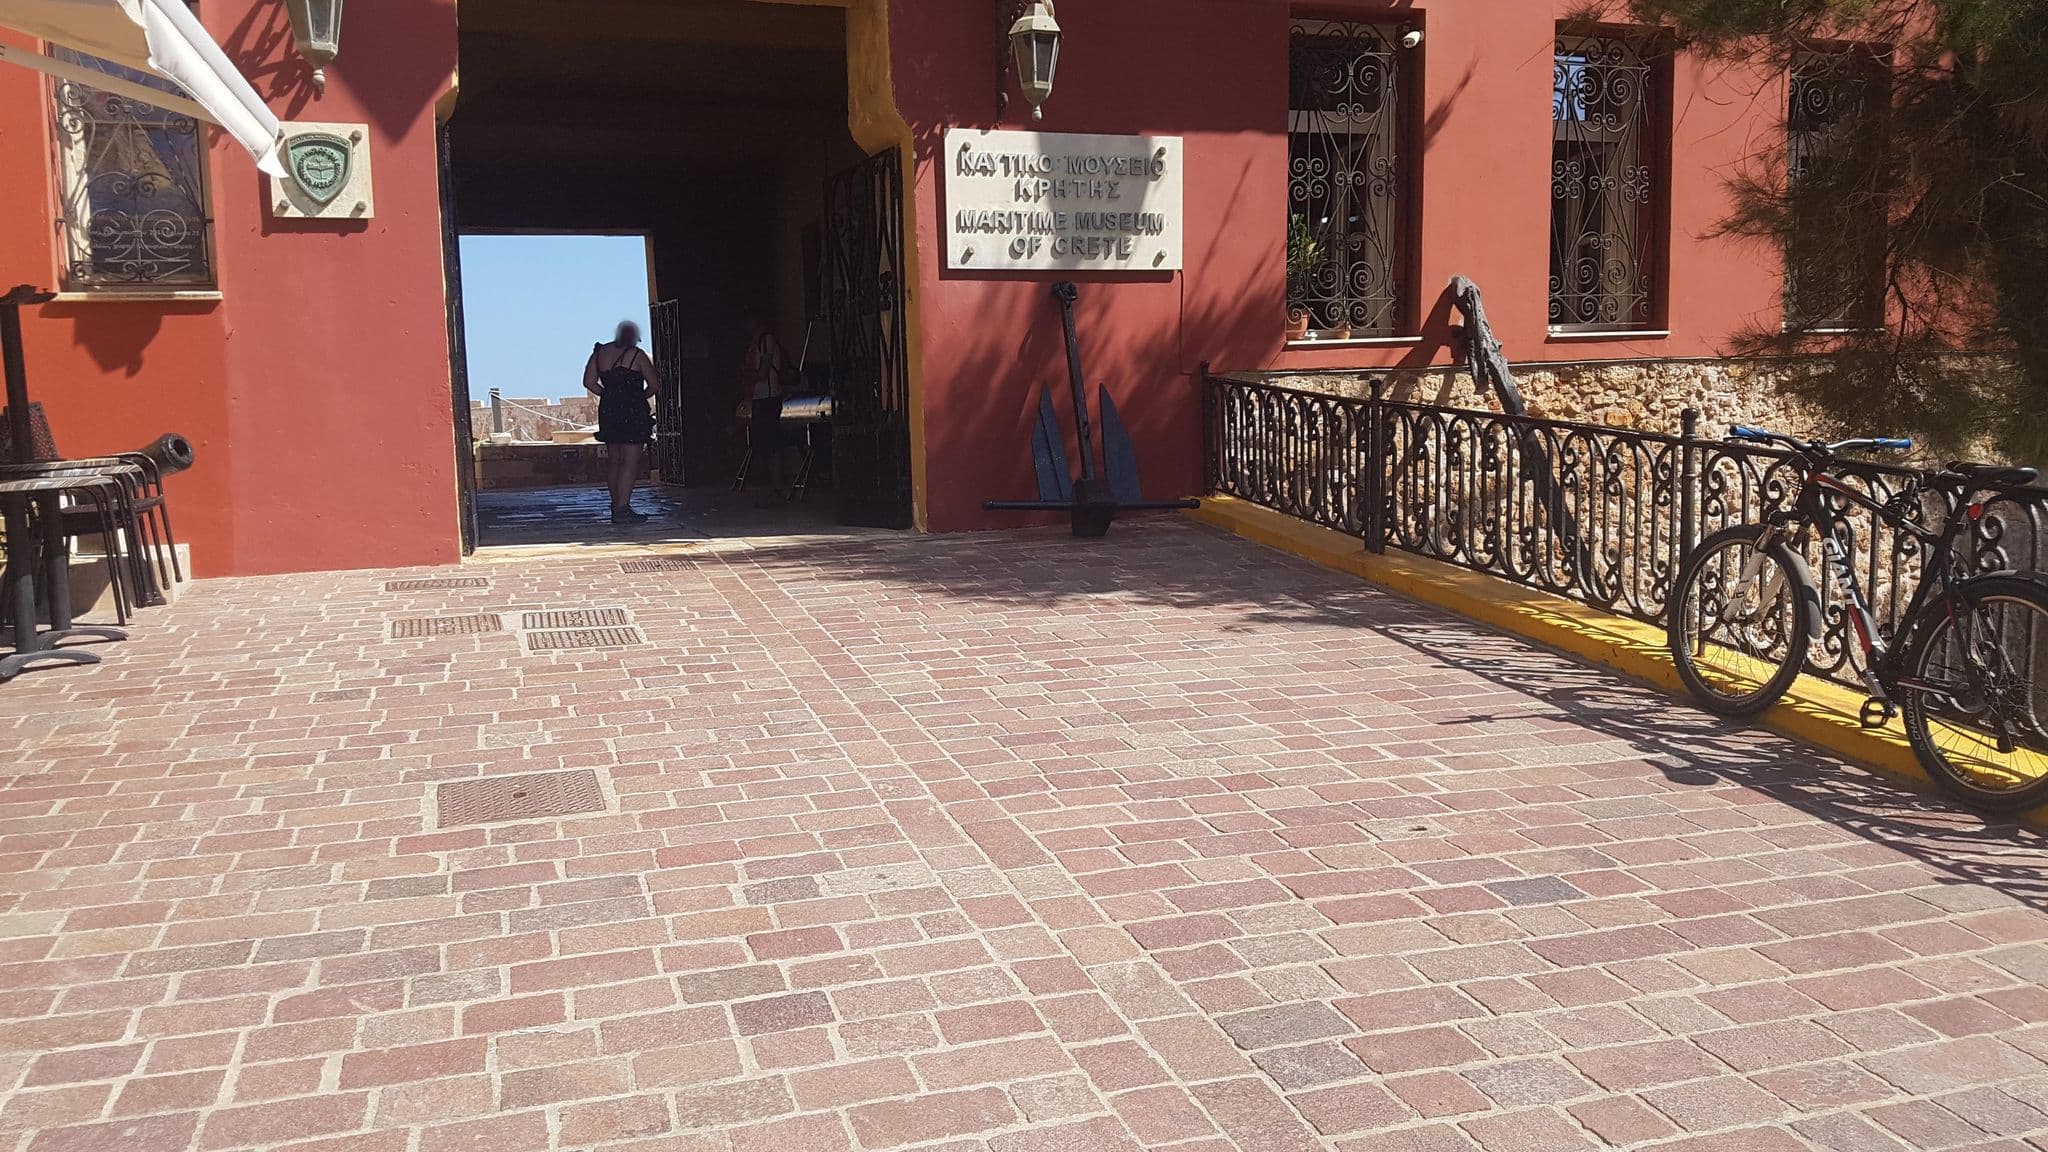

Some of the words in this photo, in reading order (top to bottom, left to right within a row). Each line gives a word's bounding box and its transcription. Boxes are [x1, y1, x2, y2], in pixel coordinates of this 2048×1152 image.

[957, 151, 1053, 177] ΝΑΥΤΙΚΟ
[1067, 153, 1167, 178] ΜΟΥΣΕΙΟ
[1015, 178, 1121, 202] ΚΡΗΤΗΣ
[957, 209, 1067, 234] MARITIME
[1075, 211, 1165, 234] MUSEUM
[1010, 235, 1042, 259] OF
[1052, 235, 1134, 260] CRETE
[1823, 537, 1861, 609] GIANT
[1905, 687, 1921, 741] CHAOYAN
